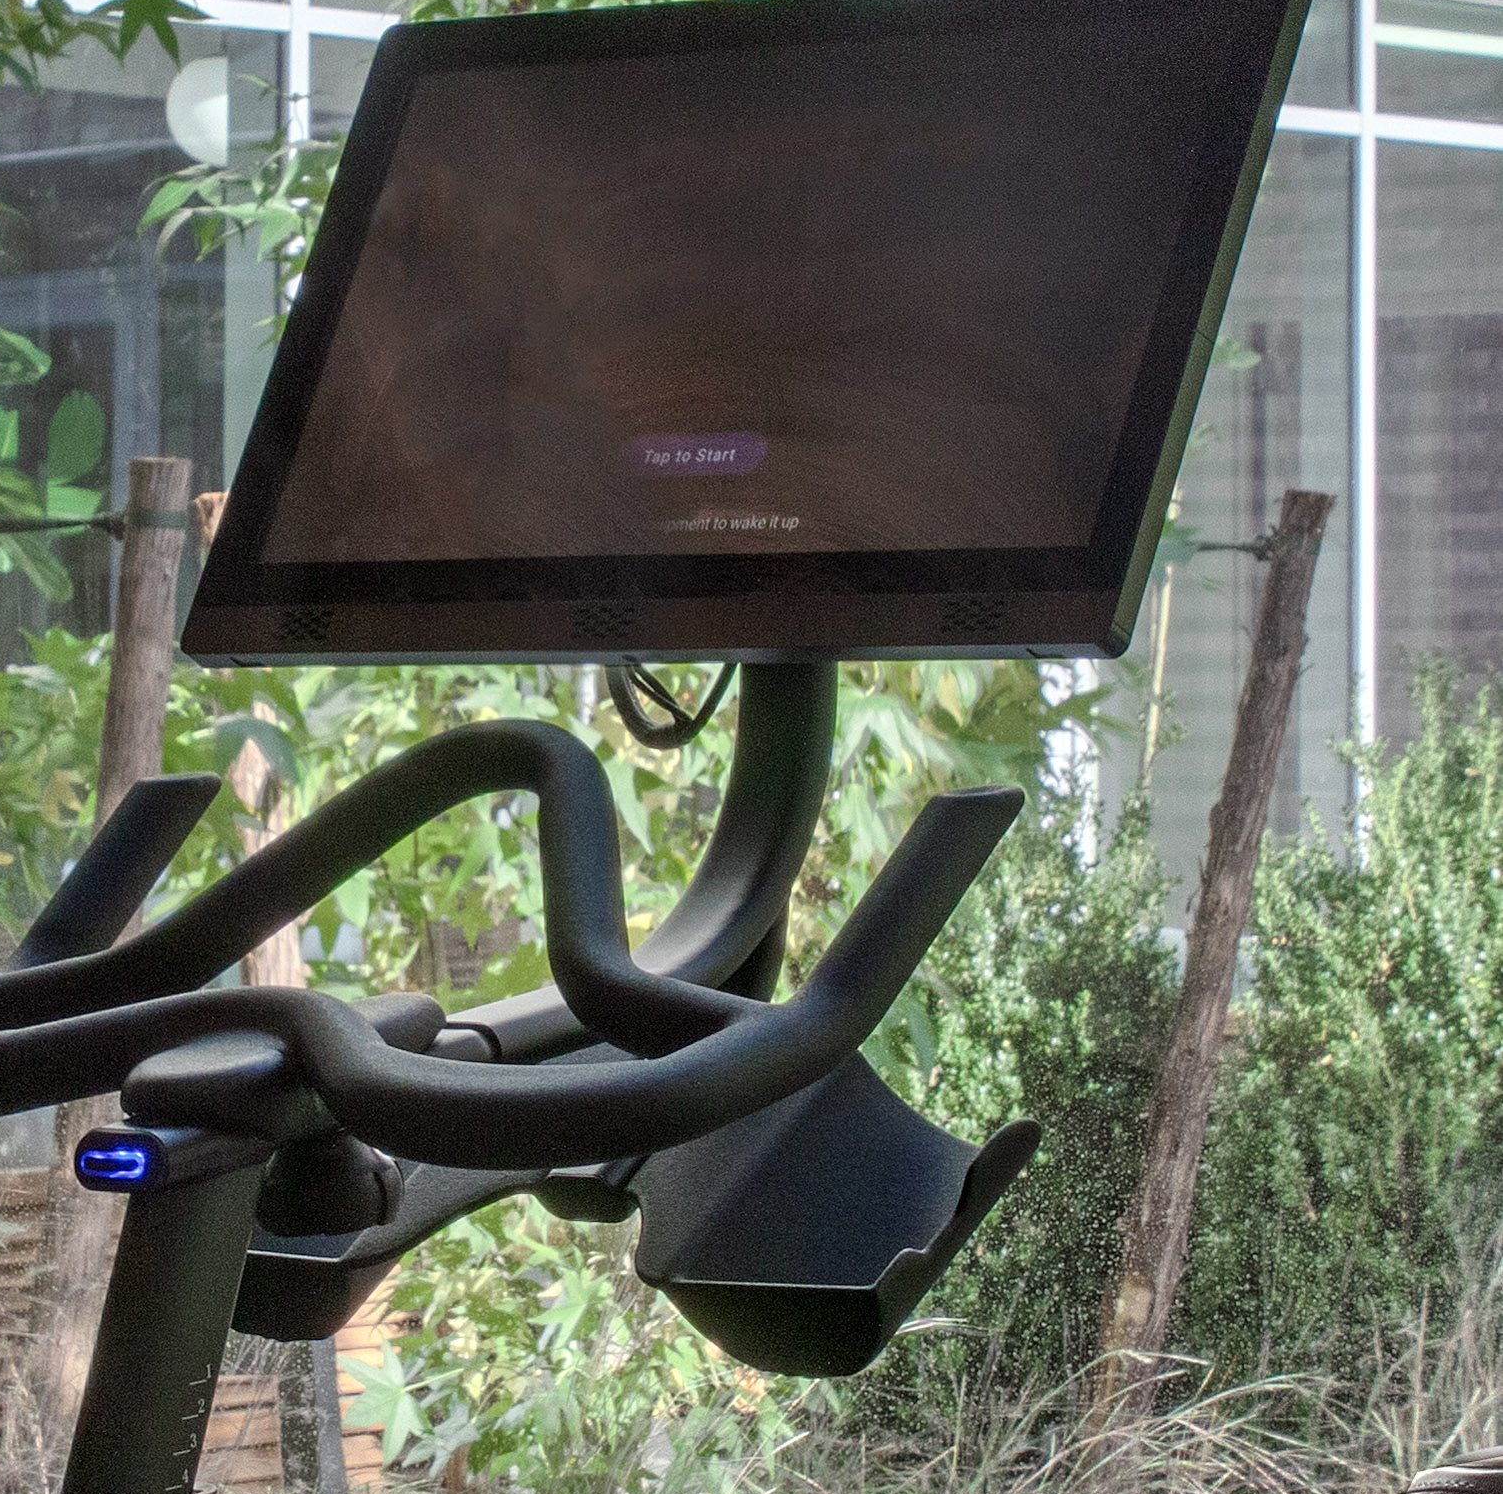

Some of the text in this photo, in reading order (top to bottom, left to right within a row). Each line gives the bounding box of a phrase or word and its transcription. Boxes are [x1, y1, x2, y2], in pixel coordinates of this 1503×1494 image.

[644, 448, 735, 466] Tap to Start
[713, 517, 727, 530] to
[729, 515, 767, 530] wake
[769, 515, 779, 528] it
[781, 517, 799, 532] up
[206, 1364, 212, 1379] 1
[198, 1398, 206, 1413] 2
[190, 1433, 197, 1448] 3
[182, 1468, 189, 1483] 4
